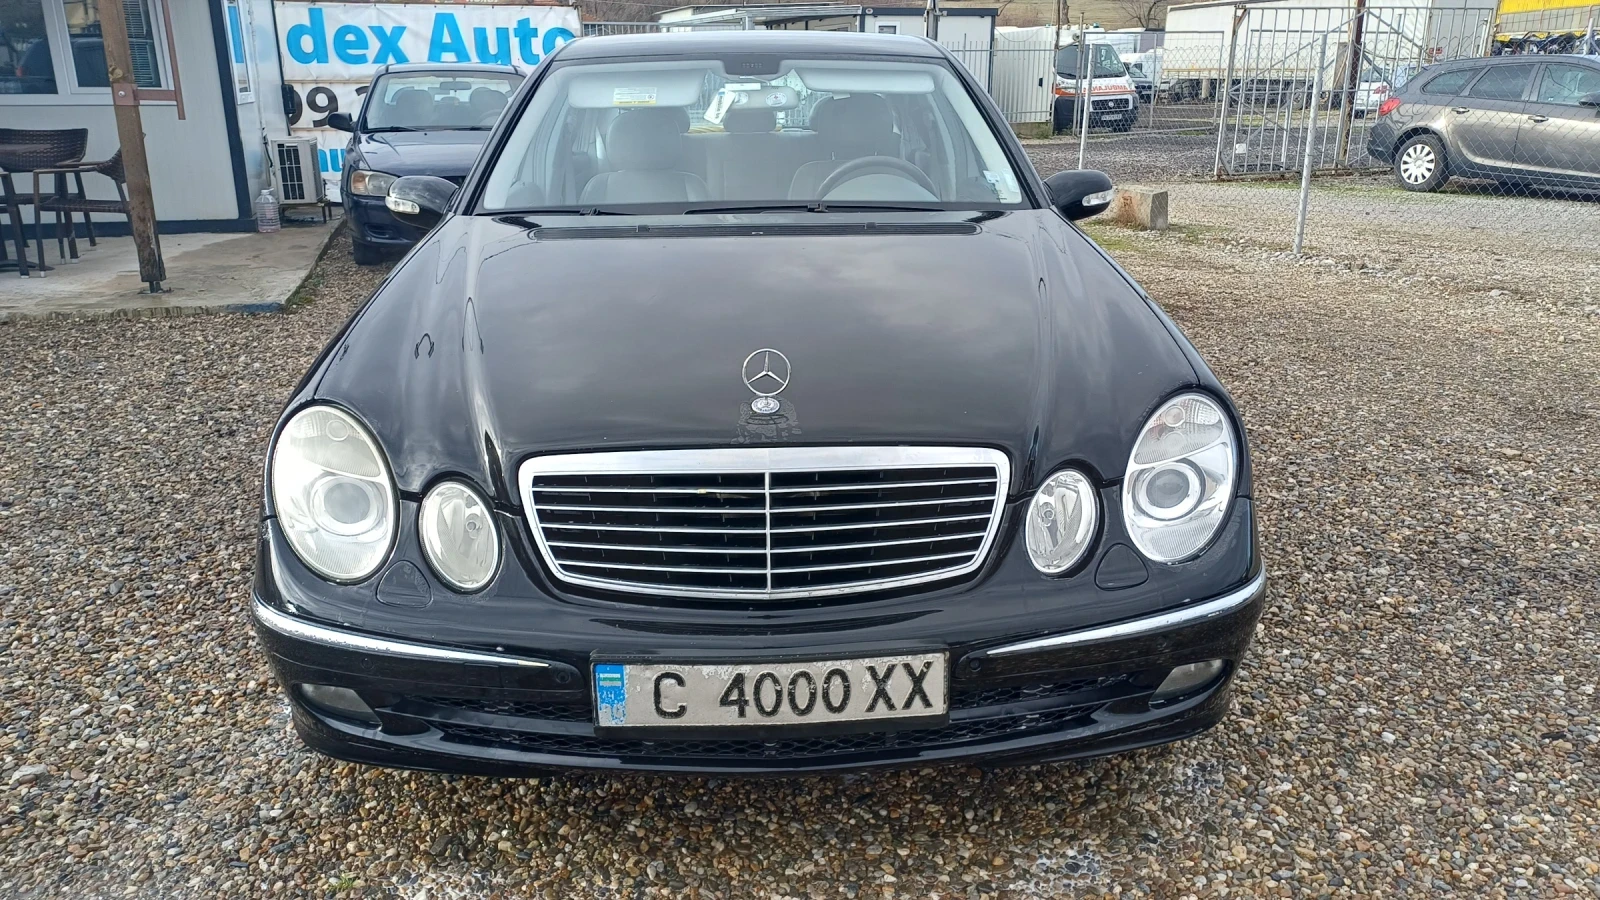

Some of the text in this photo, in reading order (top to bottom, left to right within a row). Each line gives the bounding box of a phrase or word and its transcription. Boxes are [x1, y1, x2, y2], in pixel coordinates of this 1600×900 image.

[286, 8, 410, 65] dex
[653, 671, 687, 719] C
[719, 668, 852, 718] 4000
[864, 661, 934, 713] XX
